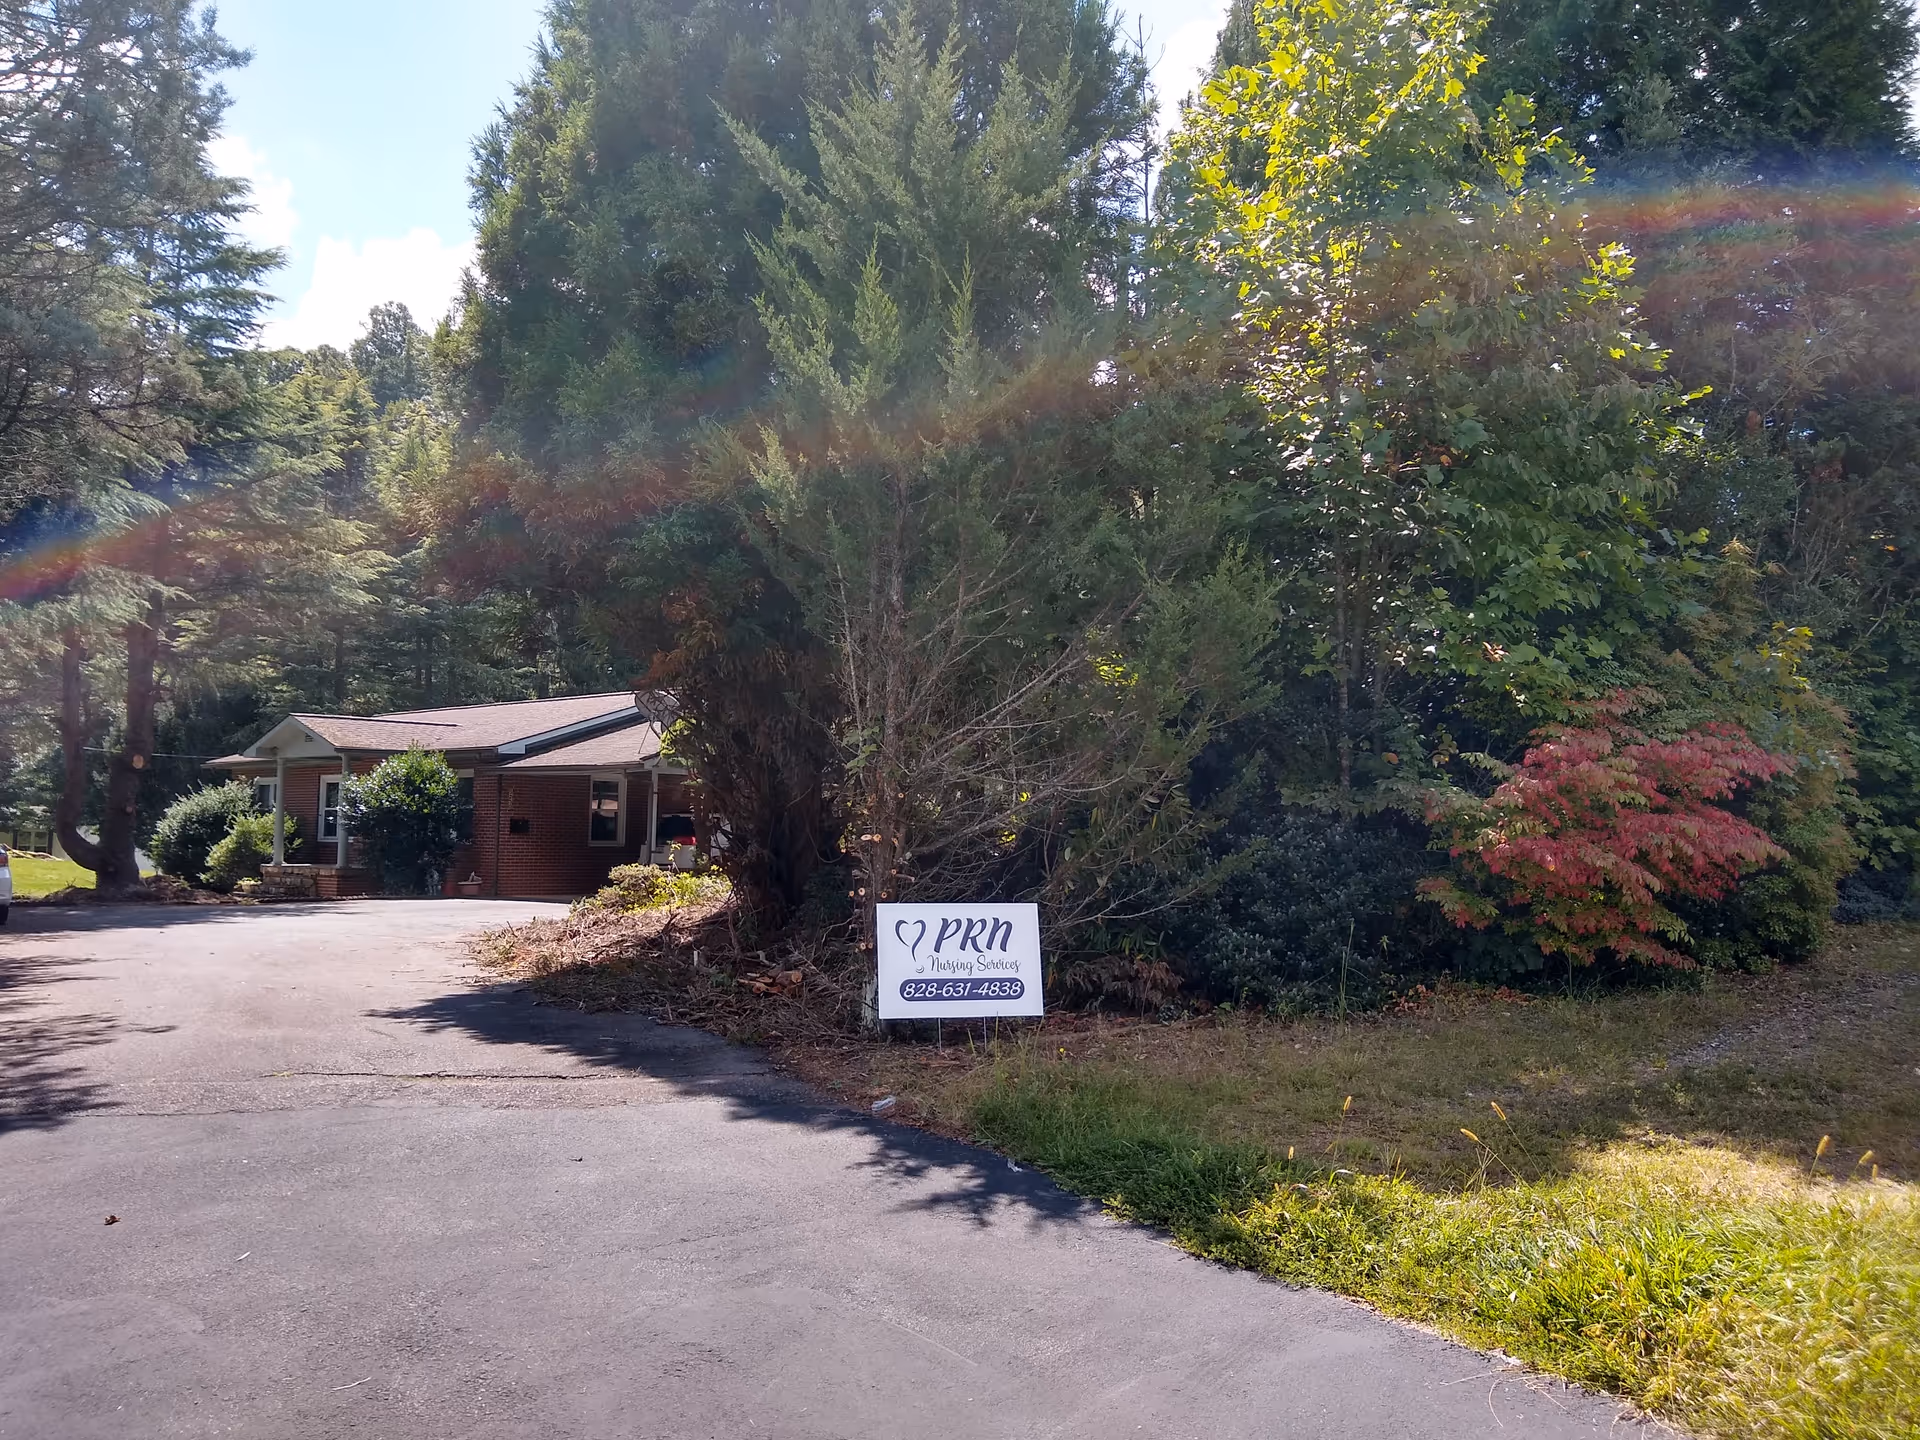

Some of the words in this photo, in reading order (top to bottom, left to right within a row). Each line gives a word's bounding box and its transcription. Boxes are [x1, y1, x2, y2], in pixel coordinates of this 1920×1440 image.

[933, 917, 1013, 953] PRN
[927, 954, 974, 976] Nursing
[976, 954, 1021, 973] Services
[903, 981, 1021, 998] 828-631-4838
